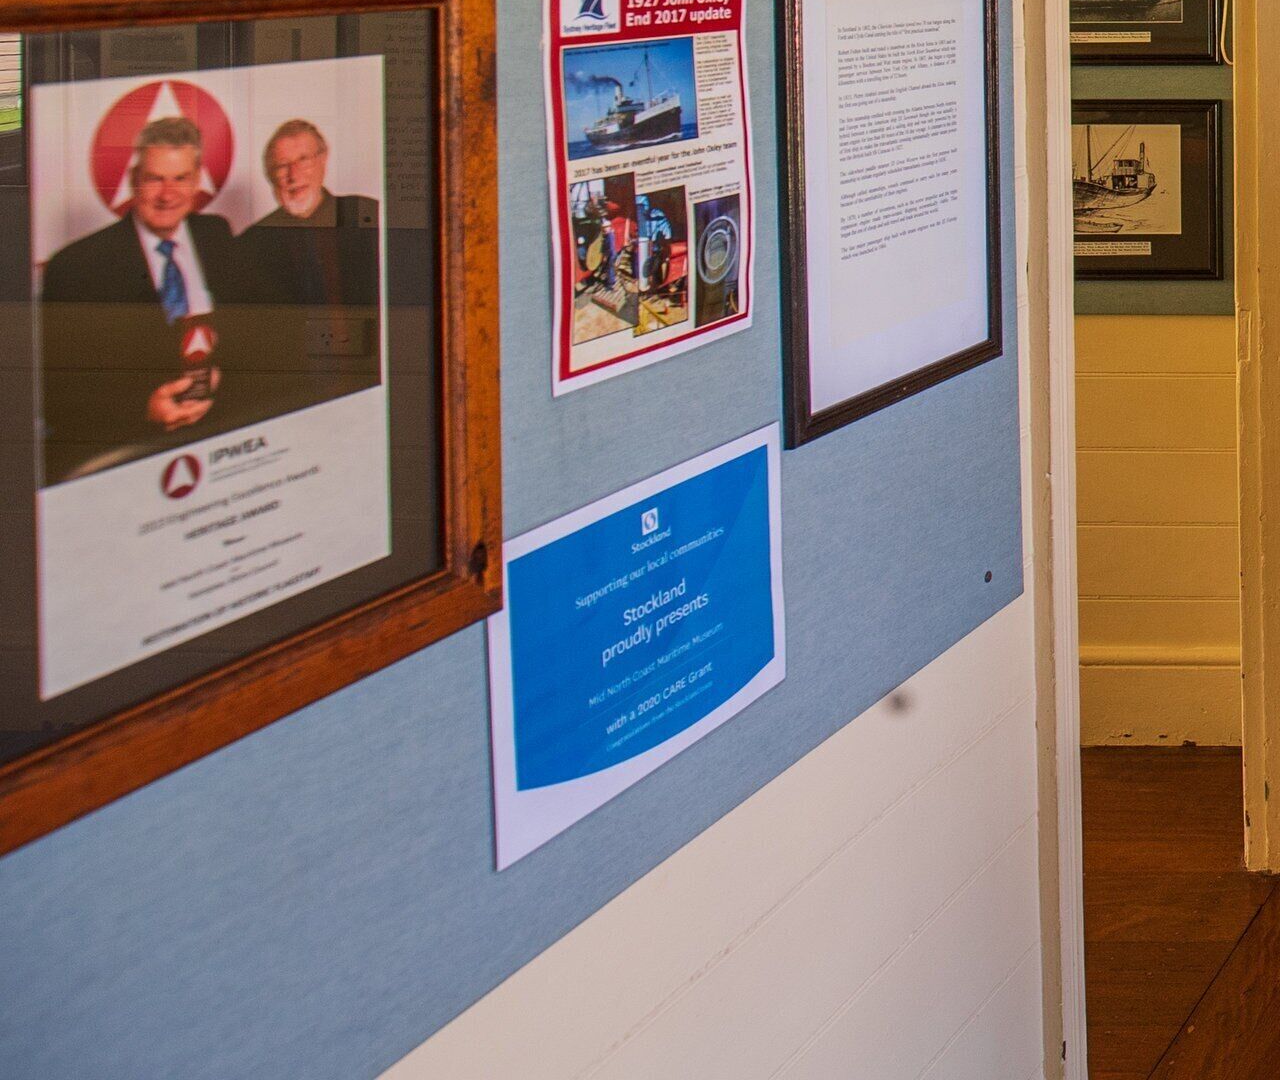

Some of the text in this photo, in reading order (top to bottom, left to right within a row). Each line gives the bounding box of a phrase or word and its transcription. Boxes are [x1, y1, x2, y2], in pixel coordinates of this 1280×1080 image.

[625, 7, 732, 27] End 2017 update
[573, 167, 590, 178] 2017
[592, 166, 603, 174] has
[605, 163, 620, 173] been
[631, 156, 655, 168] eventful
[657, 154, 670, 164] year
[681, 149, 691, 158] the
[723, 142, 737, 150] team
[209, 436, 268, 464] IPWEA
[167, 498, 229, 522] Engineering
[231, 478, 283, 502] Excellence
[286, 465, 321, 483] Awards
[184, 499, 280, 539] HERITAGE AWARD
[631, 525, 671, 554] Stockland
[575, 527, 724, 610] Supporting our local communities
[623, 577, 686, 626] Stockland
[602, 593, 709, 668] proudly presents
[588, 622, 723, 708] Mid North Coast Maritime Museum
[606, 662, 713, 735] with a 2020 CARE Grant
